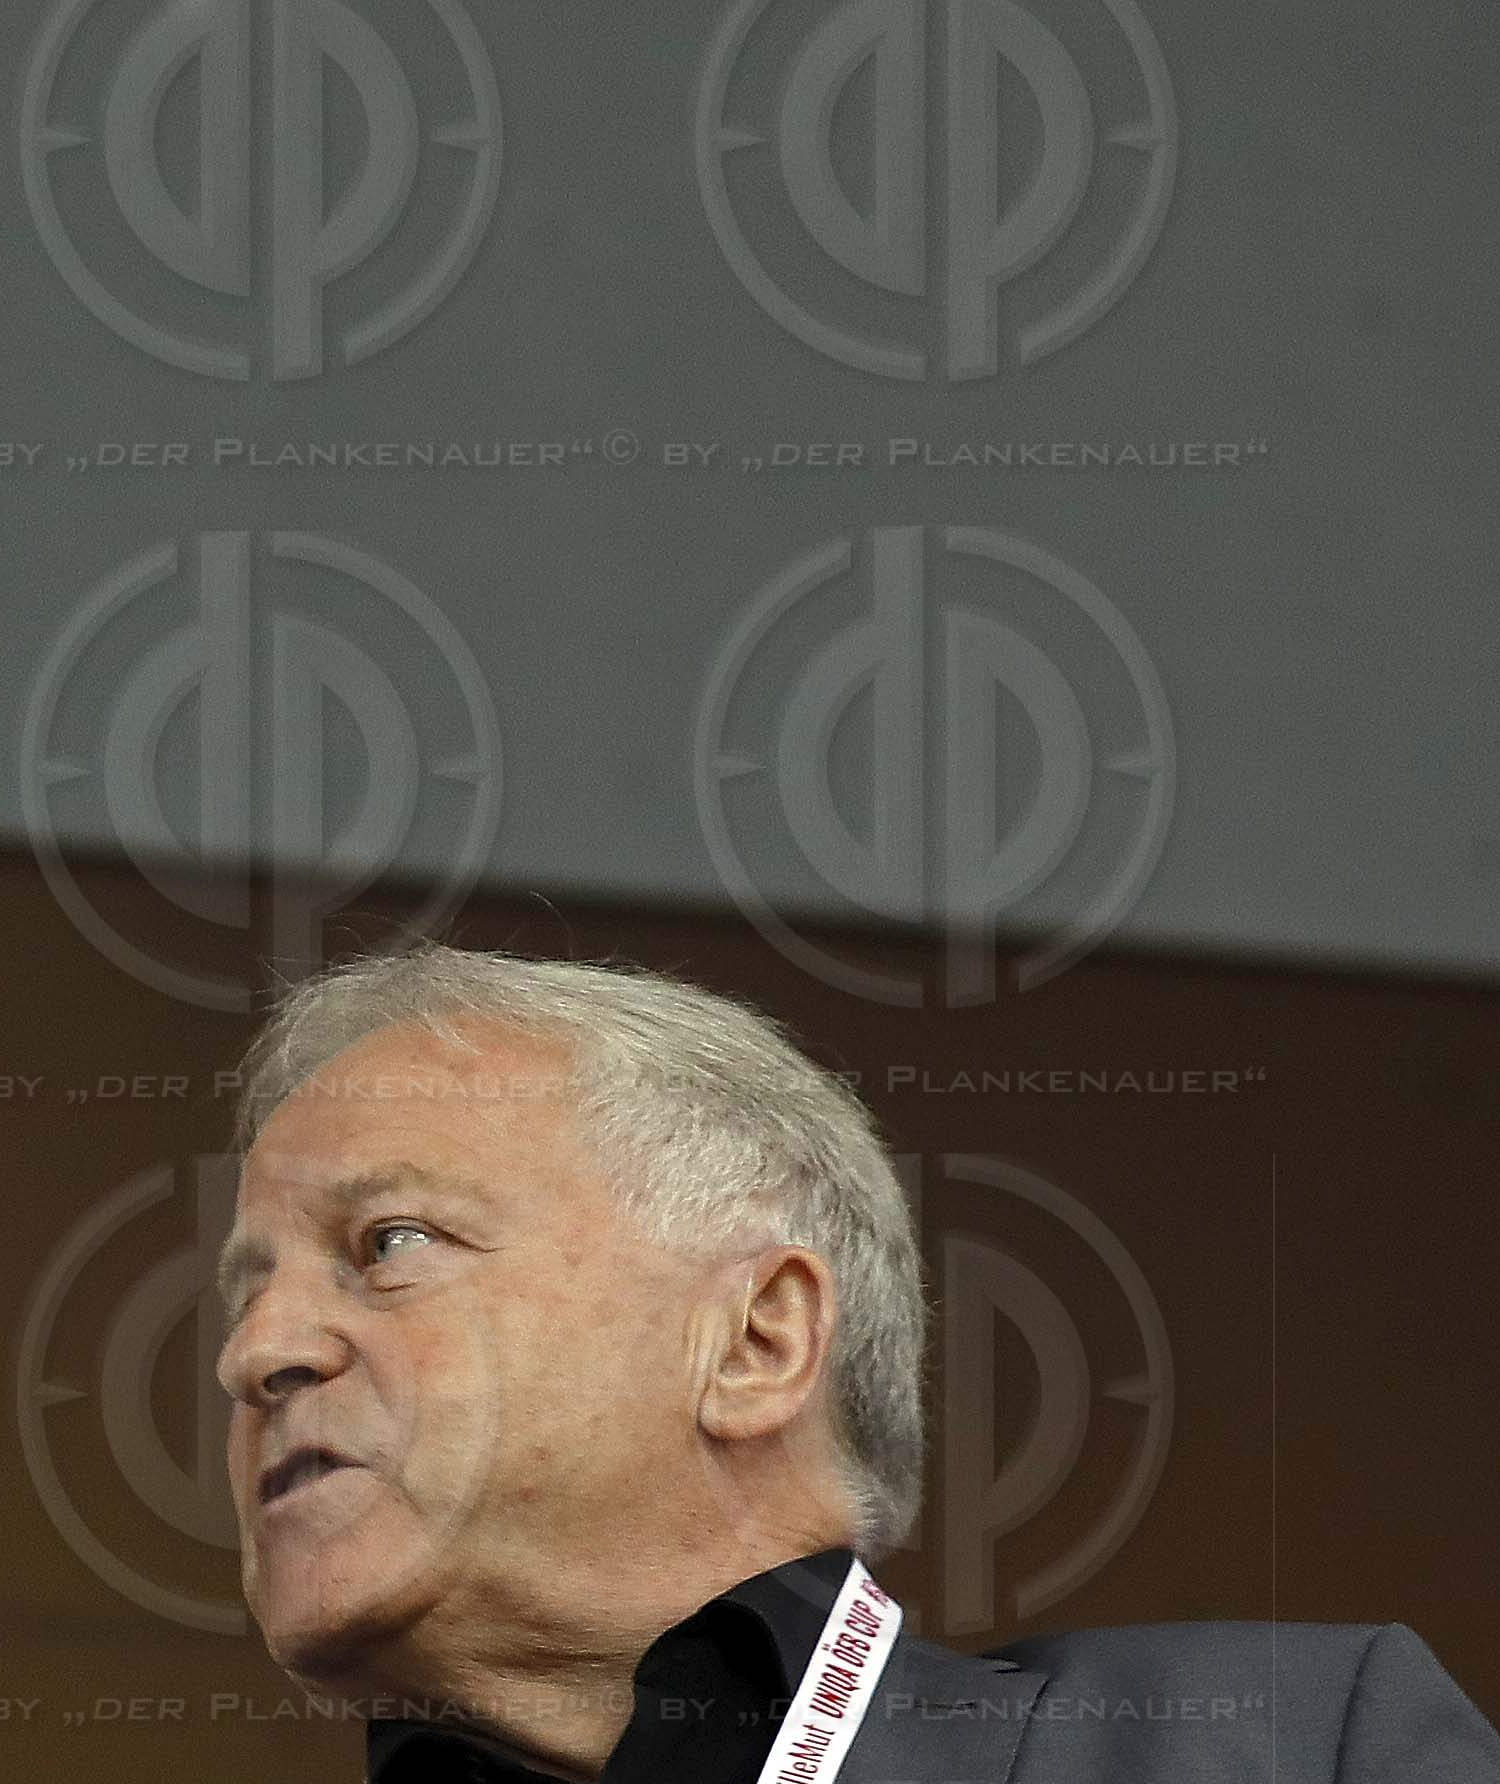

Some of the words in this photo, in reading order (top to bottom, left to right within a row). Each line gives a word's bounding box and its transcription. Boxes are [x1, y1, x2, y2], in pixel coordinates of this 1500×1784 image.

[843, 1599, 885, 1639] CUP
[821, 1631, 873, 1669] ÖFB
[808, 1662, 862, 1720] UNIQA
